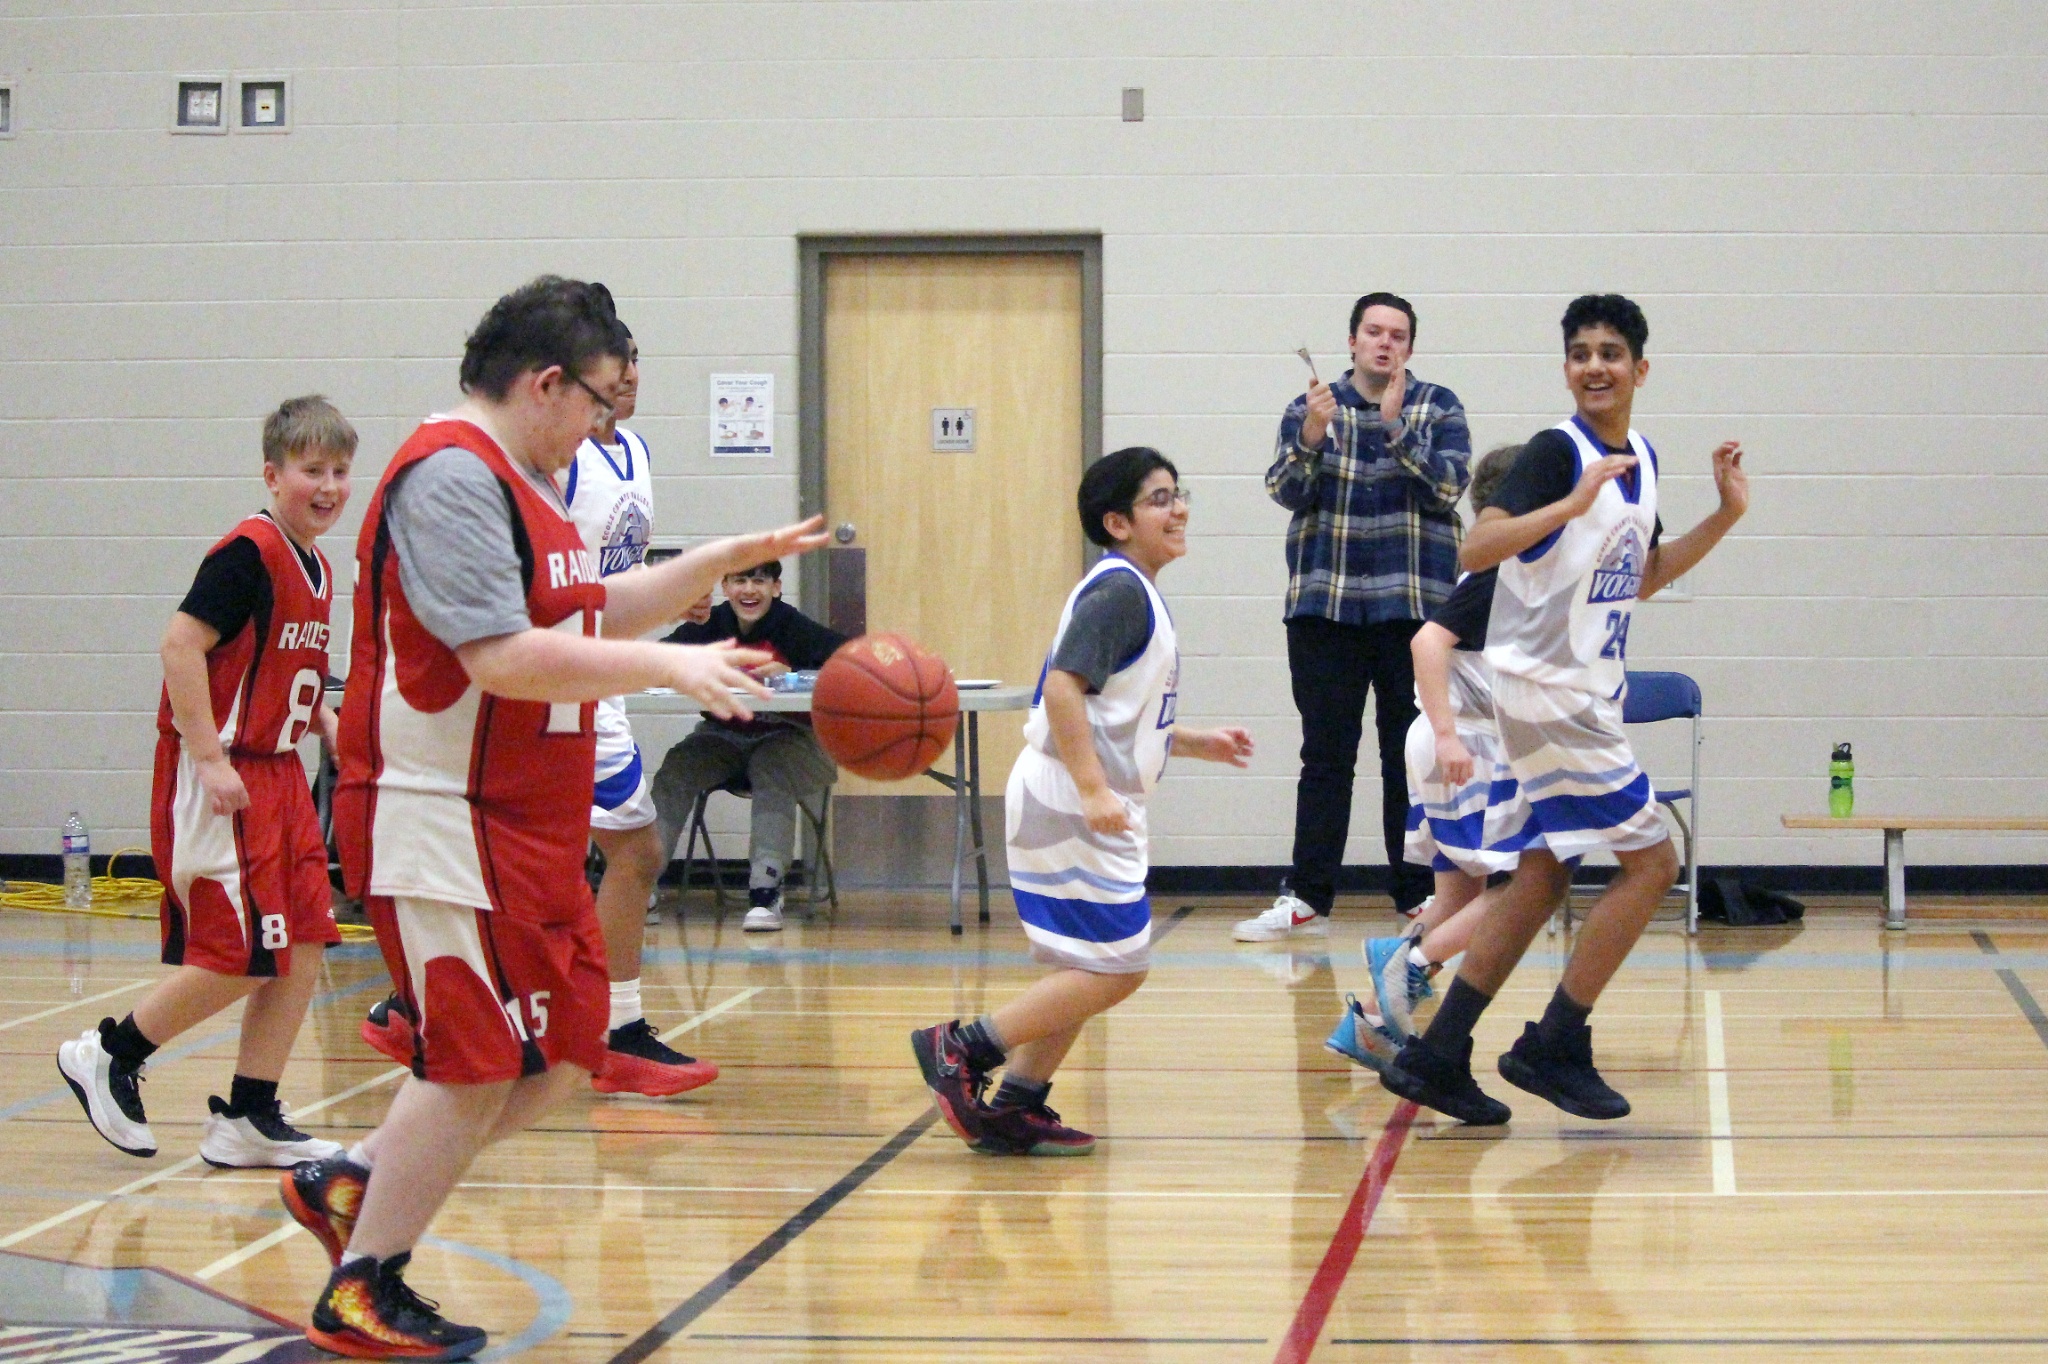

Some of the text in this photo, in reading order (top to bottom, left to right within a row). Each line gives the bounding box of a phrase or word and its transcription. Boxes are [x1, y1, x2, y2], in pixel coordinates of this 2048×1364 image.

[274, 668, 321, 754] 8
[261, 913, 289, 950] 8
[505, 990, 551, 1041] 15
